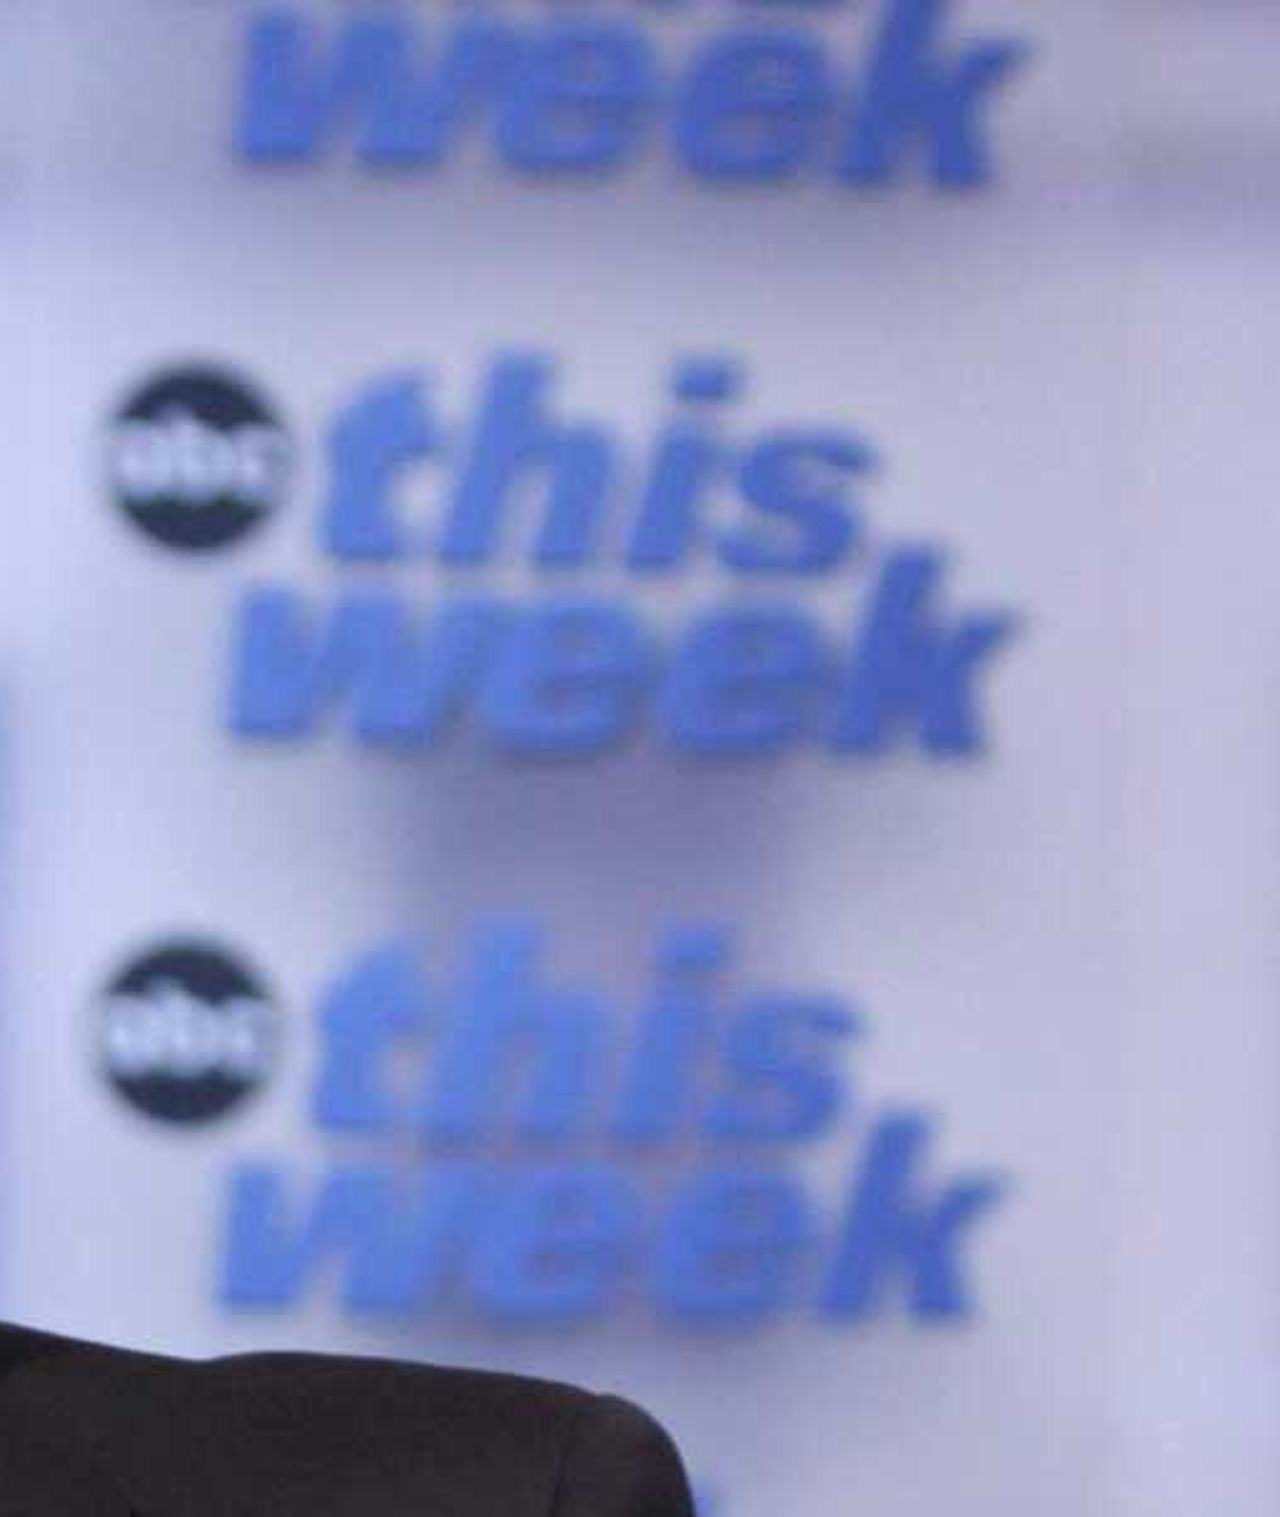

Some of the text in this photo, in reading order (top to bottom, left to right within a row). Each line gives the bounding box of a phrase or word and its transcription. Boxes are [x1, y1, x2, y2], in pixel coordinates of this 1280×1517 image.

[237, 0, 1032, 188] week
[320, 350, 878, 578] this
[228, 544, 1024, 760] week
[312, 910, 862, 1145] this
[218, 1106, 1010, 1323] week
